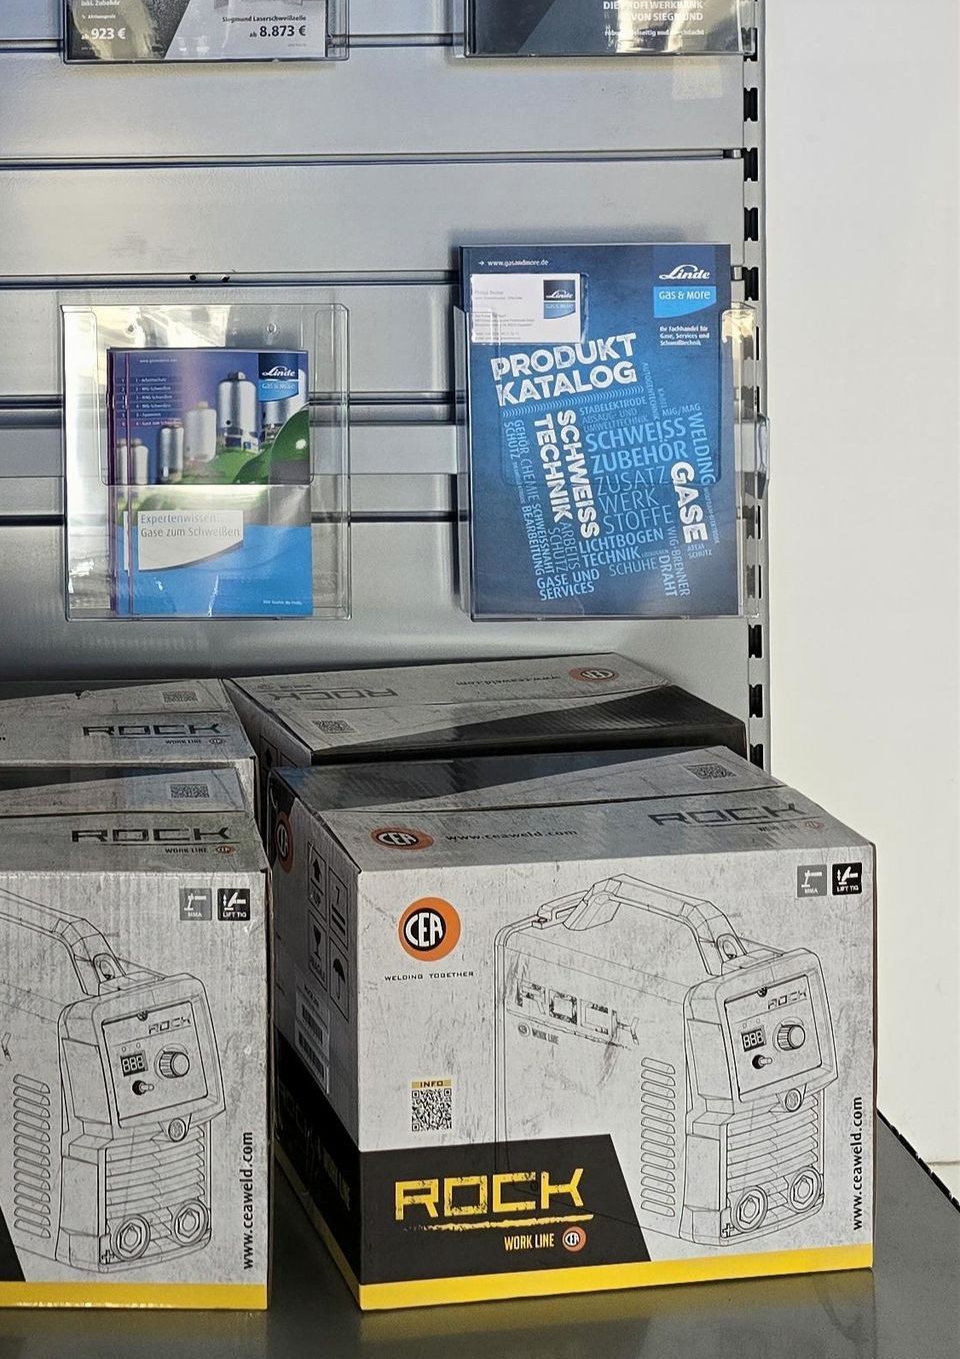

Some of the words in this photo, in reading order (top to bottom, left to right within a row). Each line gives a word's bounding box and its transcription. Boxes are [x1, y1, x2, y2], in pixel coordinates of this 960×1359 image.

[631, 13, 651, 21] VON
[91, 27, 115, 40] 923
[118, 27, 126, 40] €
[260, 25, 295, 37] 8.873
[298, 25, 306, 37] €
[487, 259, 549, 268] www.gasandmore.de
[659, 264, 710, 280] Linde
[658, 290, 676, 300] Gas
[678, 291, 685, 299] &
[686, 290, 710, 300] More
[490, 333, 637, 381] PRODUKT
[261, 366, 296, 377] Linde
[495, 360, 638, 407] KATALOG
[580, 396, 648, 416] STABELEKTRODE
[620, 408, 638, 418] UND
[662, 403, 701, 417] MIG/MAG
[583, 415, 648, 433] UMWELTTECHNIK
[585, 417, 687, 452] SCHWEISS
[503, 421, 521, 460] SCHUTZ
[688, 412, 716, 486] WELDING
[534, 413, 573, 523] TECHNIK
[590, 439, 689, 475] ZUBEHÖR
[521, 456, 540, 502] CHEMIE
[557, 409, 600, 539] SCHWEISS
[594, 466, 669, 497] ZUSATZ
[598, 487, 659, 515] WERK
[671, 462, 708, 544] GASE
[603, 504, 674, 535] STOFFE
[141, 528, 163, 537] Gase
[189, 527, 240, 537] Schweißen
[521, 505, 545, 577] BEARBEITUNG
[531, 502, 555, 574] SCHWEISSNAHT
[579, 527, 664, 555] LICHTBOGEN
[547, 526, 569, 573] SCHUTZ
[559, 522, 581, 571] ARBEITS
[581, 545, 642, 569] TECHNIK
[608, 557, 659, 578] SCHUHE
[666, 525, 691, 597] WIG-BRENNER
[536, 573, 568, 590] GASE
[572, 569, 600, 583] UND
[658, 555, 678, 597] DRAHT
[539, 581, 595, 602] SERVICES
[455, 673, 562, 686] www.ceaweld.com
[267, 687, 399, 701] ROCK
[82, 723, 223, 737] ROCK
[648, 802, 808, 826] ROCK
[72, 826, 231, 842] ROCK
[376, 831, 418, 845] CEA
[445, 828, 579, 842] www.ceaweld.com
[836, 885, 849, 893] LIFT
[404, 912, 443, 948] CEA
[384, 973, 424, 982] WELDING
[429, 971, 475, 979] TOGETHER
[419, 1080, 444, 1088] INFO
[849, 1096, 863, 1231] www.ceaweld.com
[239, 1132, 254, 1270] www.ceaweld.com
[395, 1168, 584, 1221] ROCK
[504, 1234, 533, 1251] WORK
[534, 1232, 555, 1248] LINE
